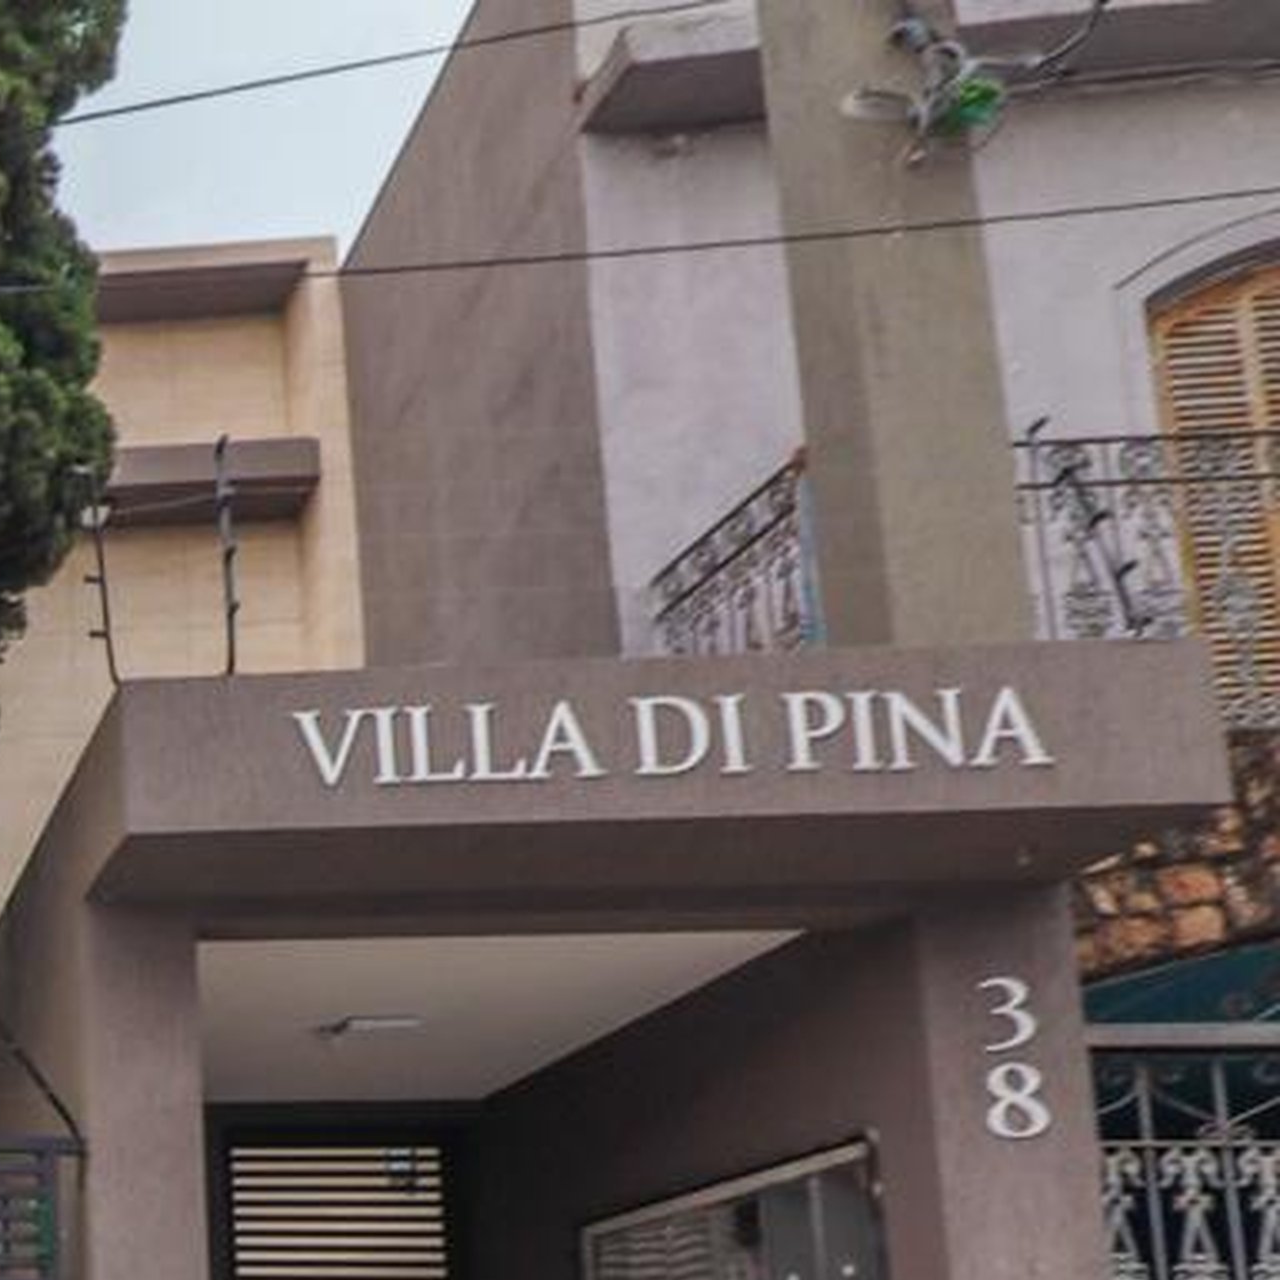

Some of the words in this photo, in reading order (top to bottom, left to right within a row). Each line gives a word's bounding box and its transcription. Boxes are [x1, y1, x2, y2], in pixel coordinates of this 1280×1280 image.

[294, 700, 605, 786] VILLA
[631, 694, 746, 776] DI
[781, 686, 1053, 771] PINA
